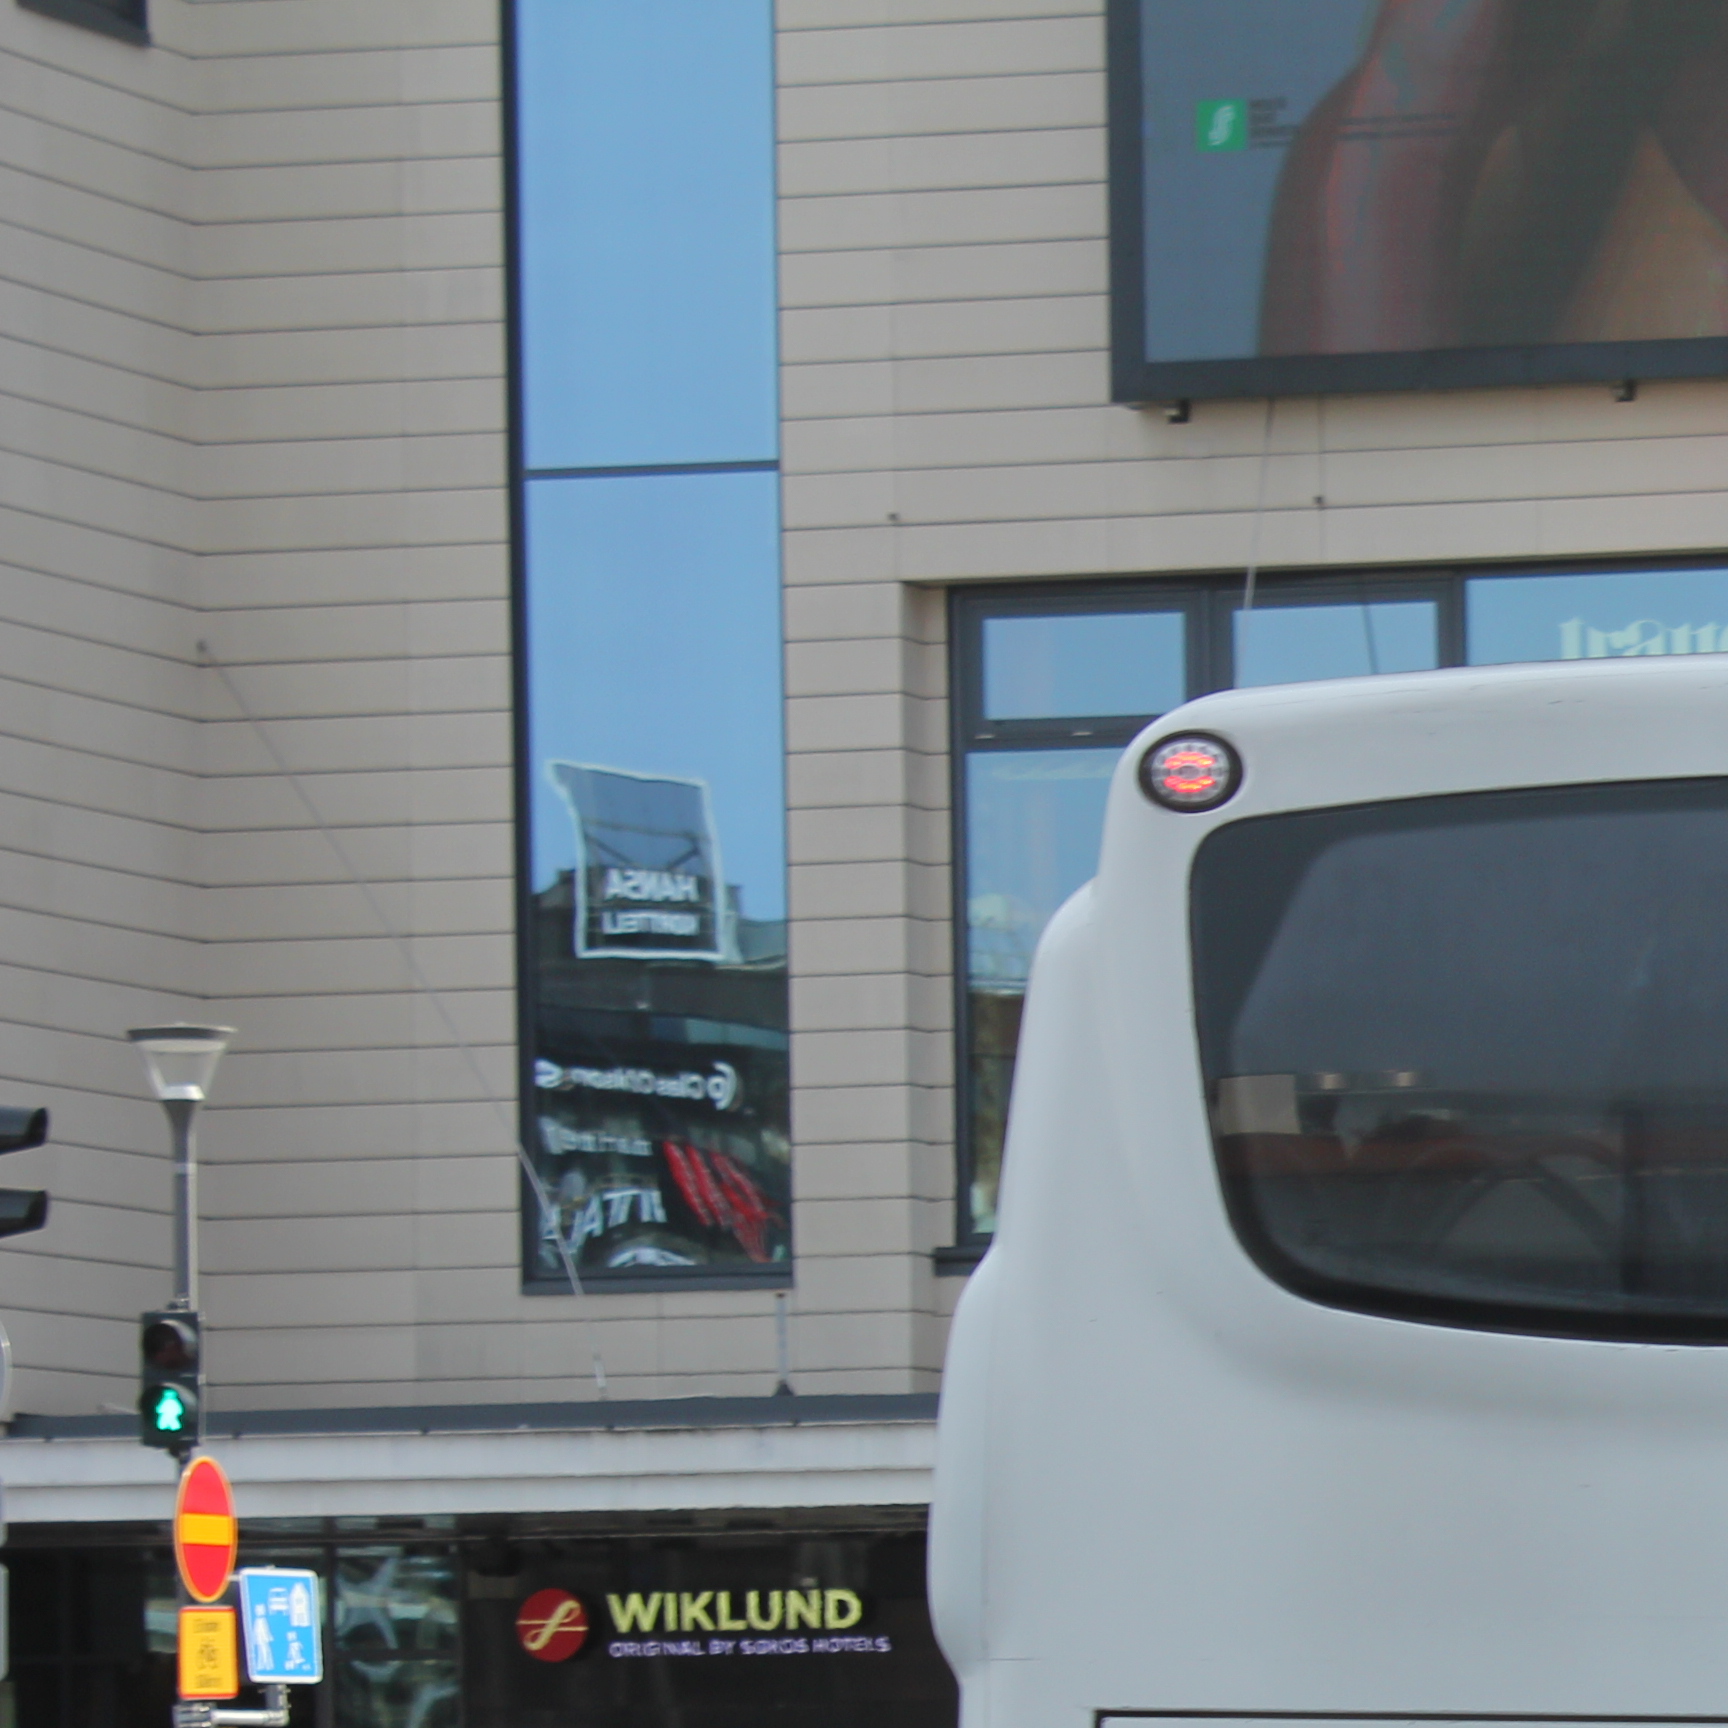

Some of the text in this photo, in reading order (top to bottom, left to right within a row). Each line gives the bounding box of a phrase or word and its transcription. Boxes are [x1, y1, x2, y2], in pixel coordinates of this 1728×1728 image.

[606, 1589, 862, 1634] WIKLUND
[609, 1640, 705, 1657] ORIGINAL
[708, 1639, 736, 1655] BY
[812, 1635, 892, 1653] HOTELS
